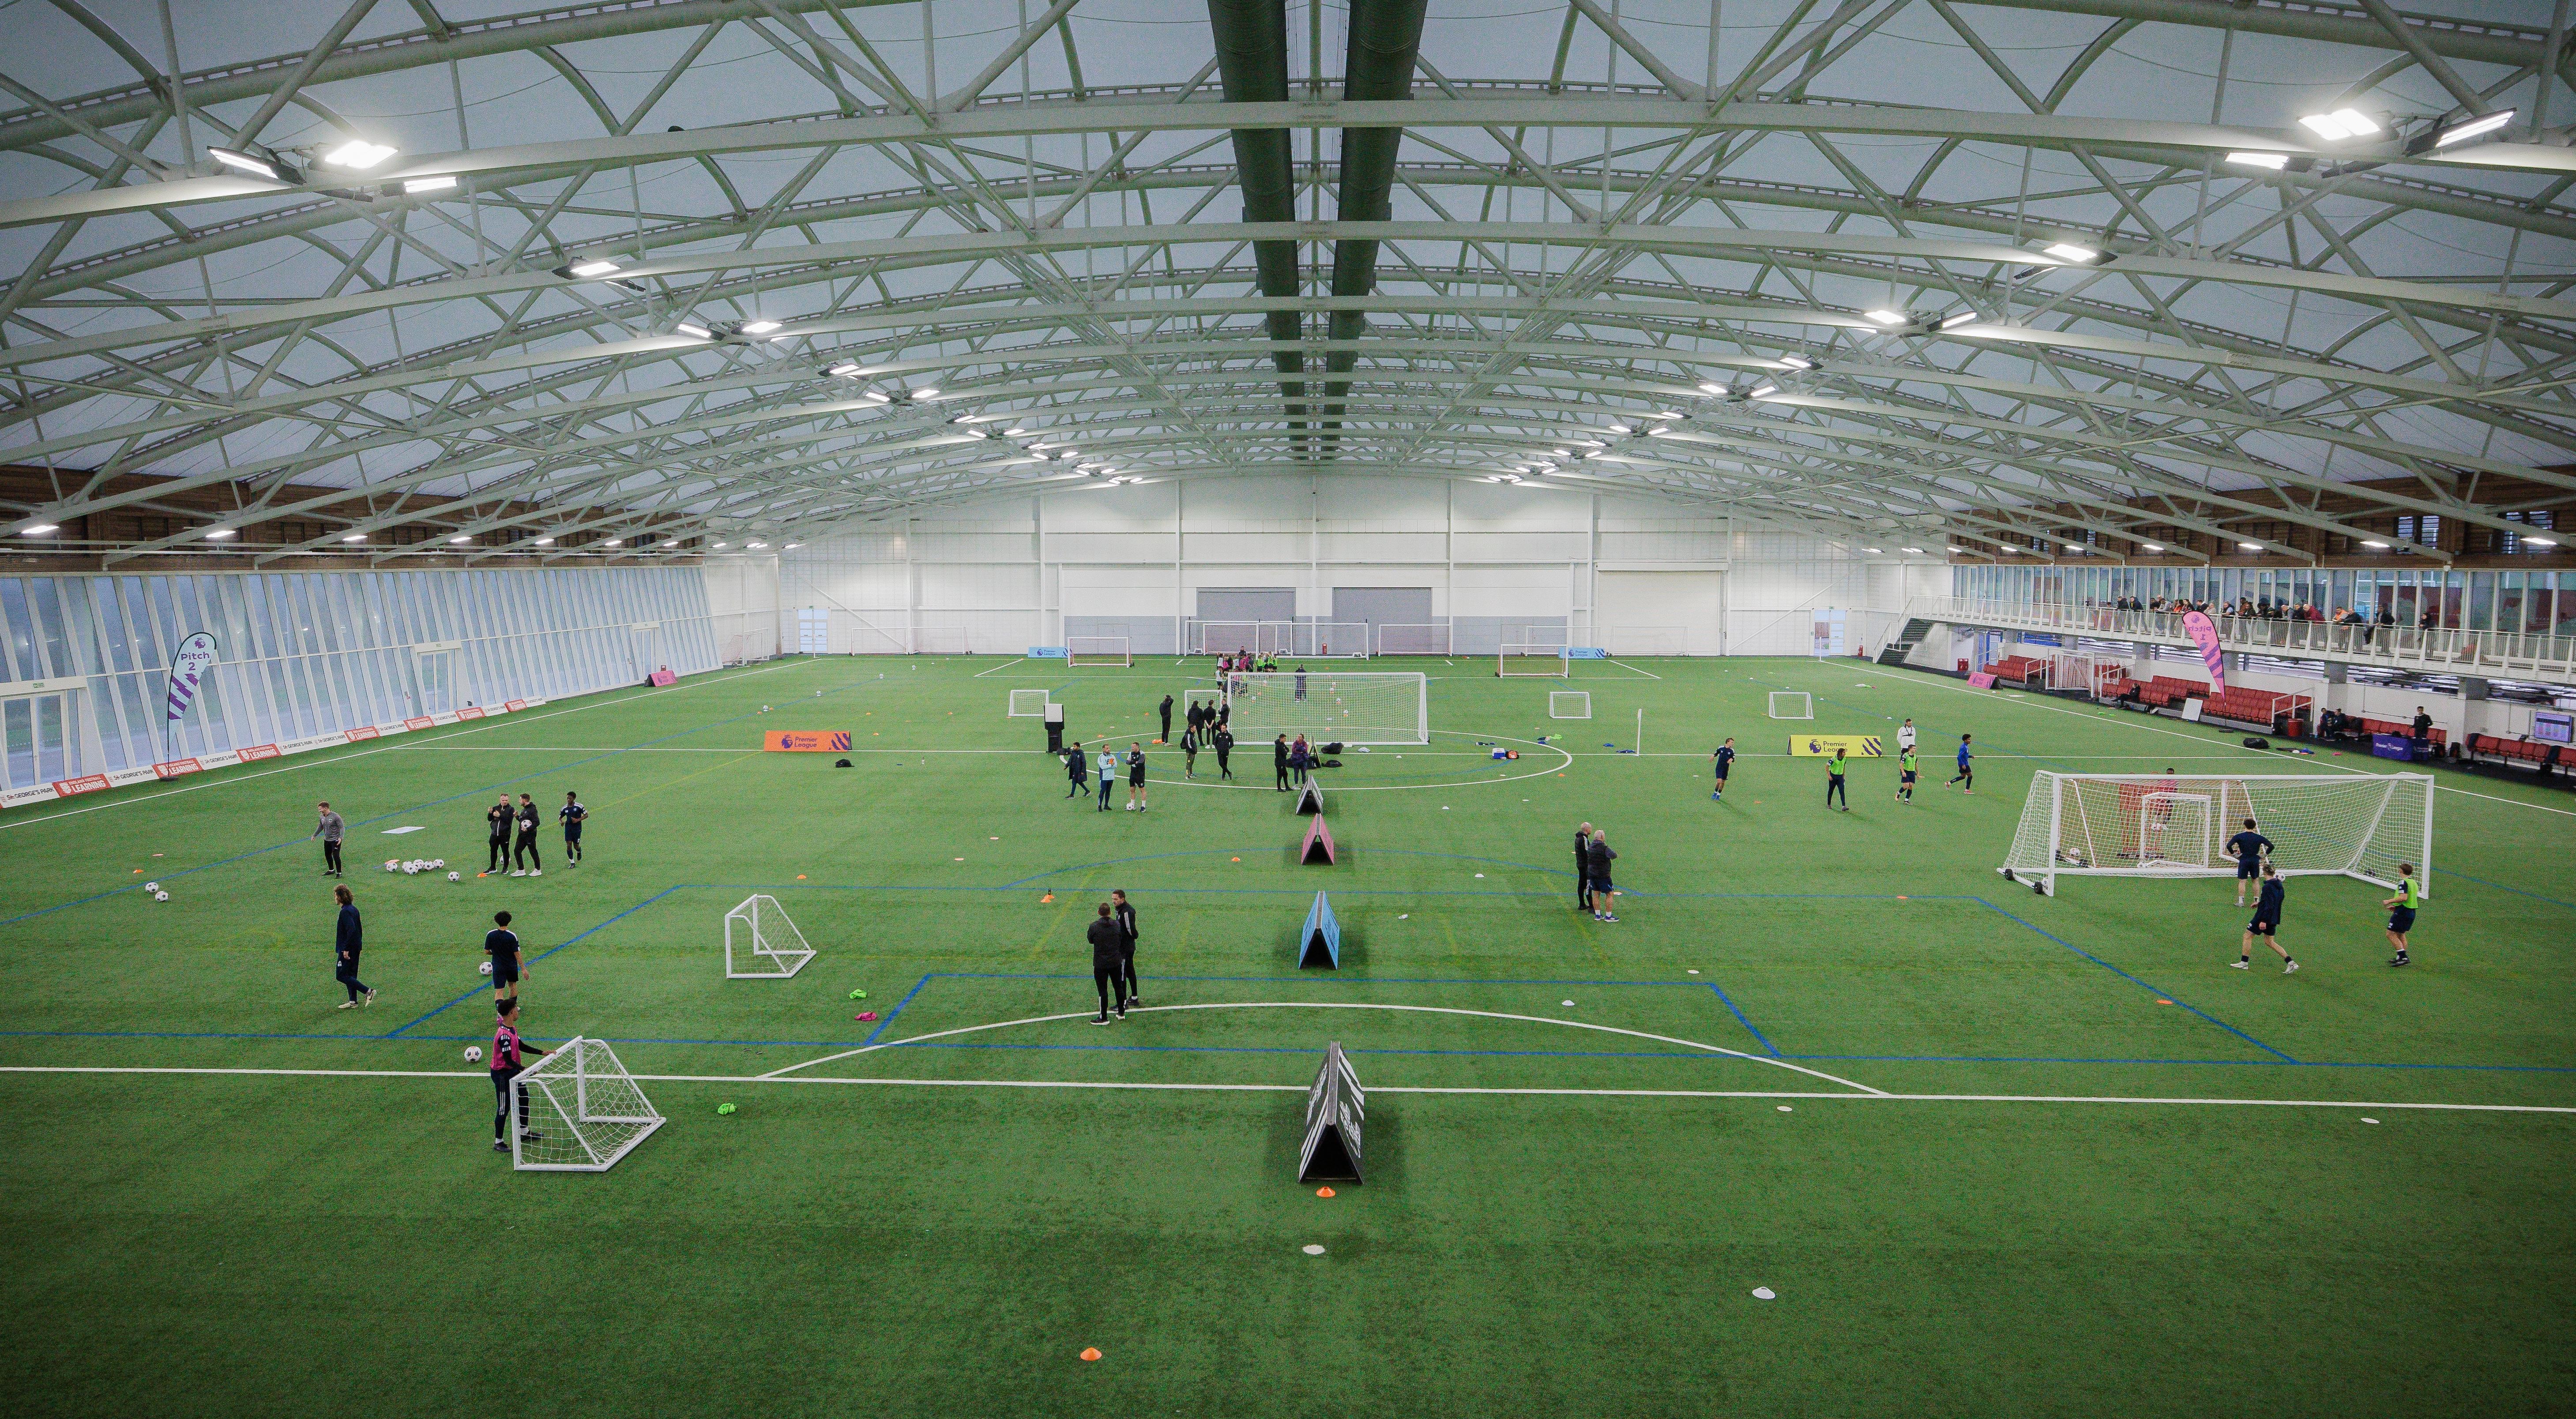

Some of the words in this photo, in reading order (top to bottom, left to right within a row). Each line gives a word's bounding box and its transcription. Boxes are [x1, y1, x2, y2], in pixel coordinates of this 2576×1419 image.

[181, 651, 210, 661] Pitch
[188, 662, 196, 671] 2
[355, 731, 377, 740] LEARNING
[250, 749, 277, 759] LEARNING
[169, 763, 199, 774] LEARNING
[120, 771, 142, 779] GEORGE'S
[71, 781, 106, 792] LEARNING
[15, 790, 40, 799] GEORGE'S
